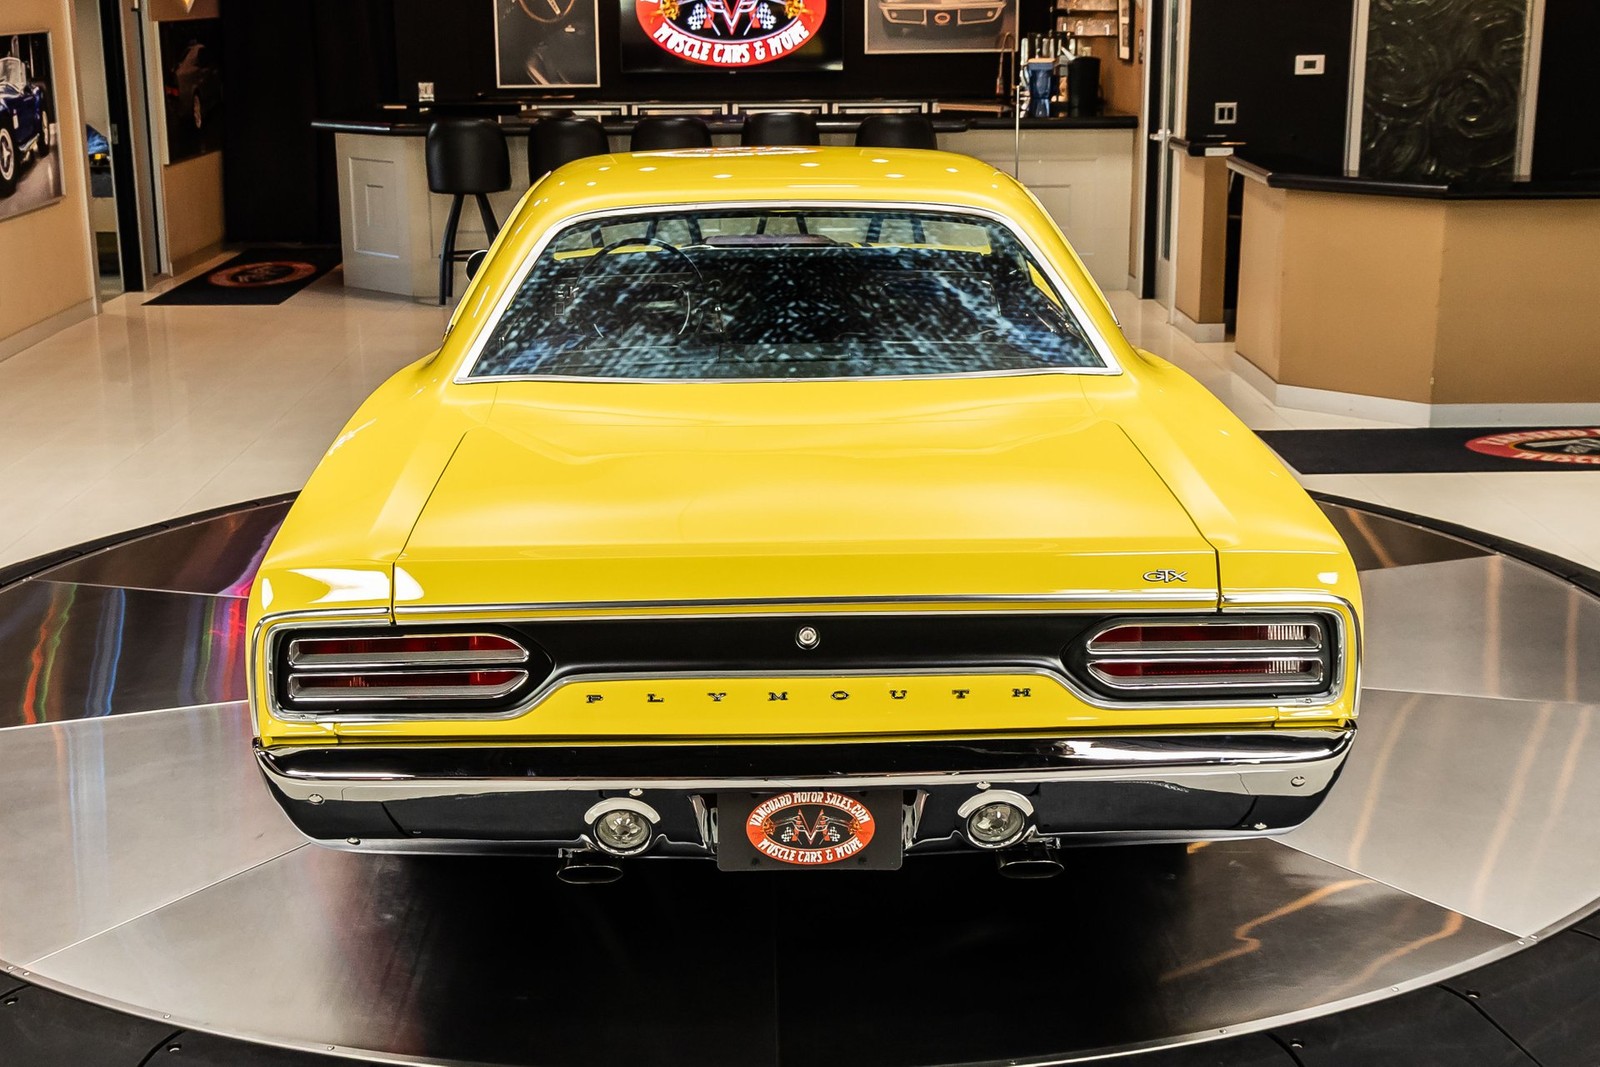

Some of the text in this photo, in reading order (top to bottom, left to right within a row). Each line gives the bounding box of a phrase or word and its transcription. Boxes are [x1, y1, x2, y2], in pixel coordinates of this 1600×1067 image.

[653, 20, 810, 63] MUSCLE CARS & MORE
[1142, 568, 1188, 583] GTX
[585, 687, 1032, 704] PLYMOUTH
[750, 791, 871, 826] VANGUARD MOTOR SALES.COM
[757, 837, 863, 863] MUSCLE CARS & MORE
